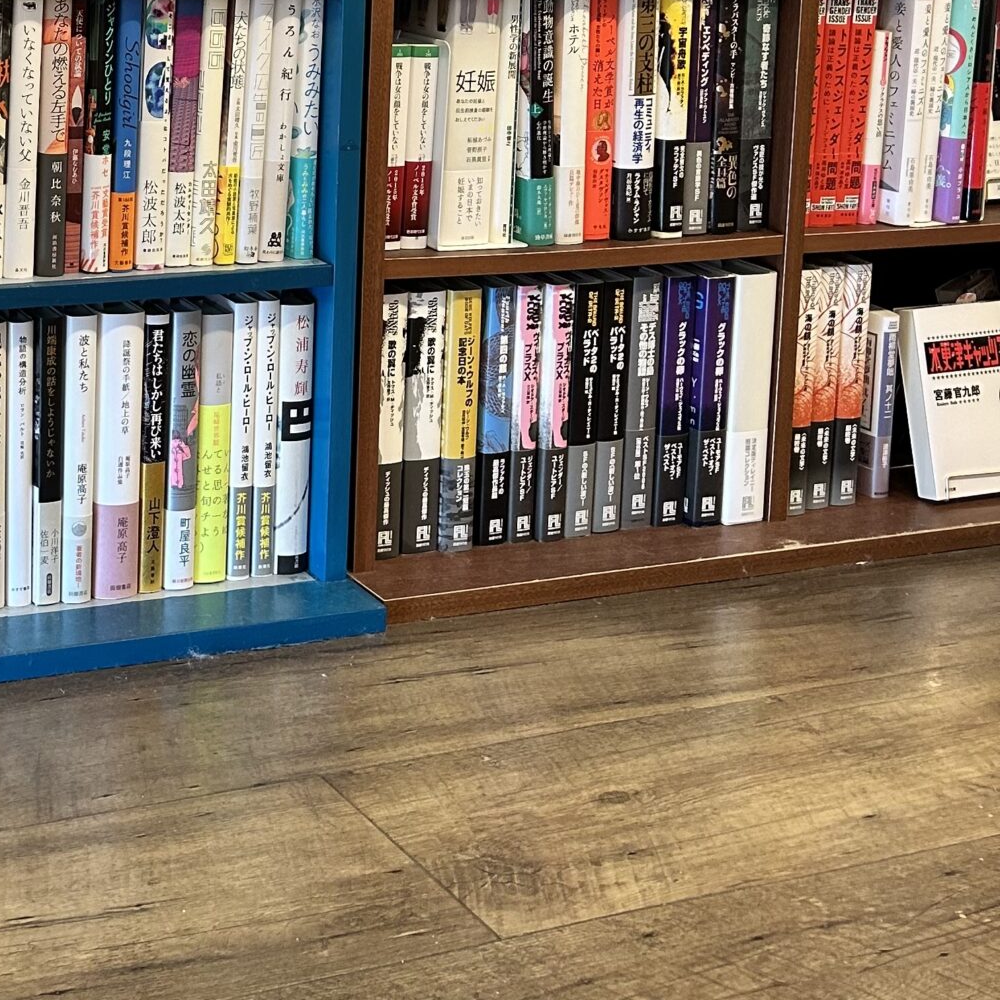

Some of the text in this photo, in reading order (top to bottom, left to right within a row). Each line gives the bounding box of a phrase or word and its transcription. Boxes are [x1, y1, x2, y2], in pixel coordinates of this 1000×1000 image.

[829, 15, 845, 23] ISSUE
[50, 0, 69, 142] あなたの燃える左手で
[103, 2, 115, 105] ジャクソンひとり
[280, 4, 296, 102] うろん紀行
[456, 70, 495, 93] 妊娠
[19, 24, 36, 162] いなくなっていない父
[122, 37, 140, 135] Schoolgirl
[303, 45, 321, 136] うみみたい
[631, 98, 644, 164] 再生の経済学
[50, 161, 62, 222] 朝比奈秋
[172, 182, 186, 234] 松波太郎
[726, 156, 737, 198] 異色の
[142, 180, 158, 244] 松波太郎
[77, 335, 90, 393] 波と私たち
[181, 330, 197, 397] 恋の幽霊
[294, 315, 310, 396] 松浦寿輝
[150, 330, 164, 458] 君たちはしかし再び来い
[934, 384, 980, 401] 宮藤官九郎
[117, 517, 128, 564] 庵原高子
[147, 497, 160, 553] 山下澄人
[179, 518, 190, 567] 町屋良平
